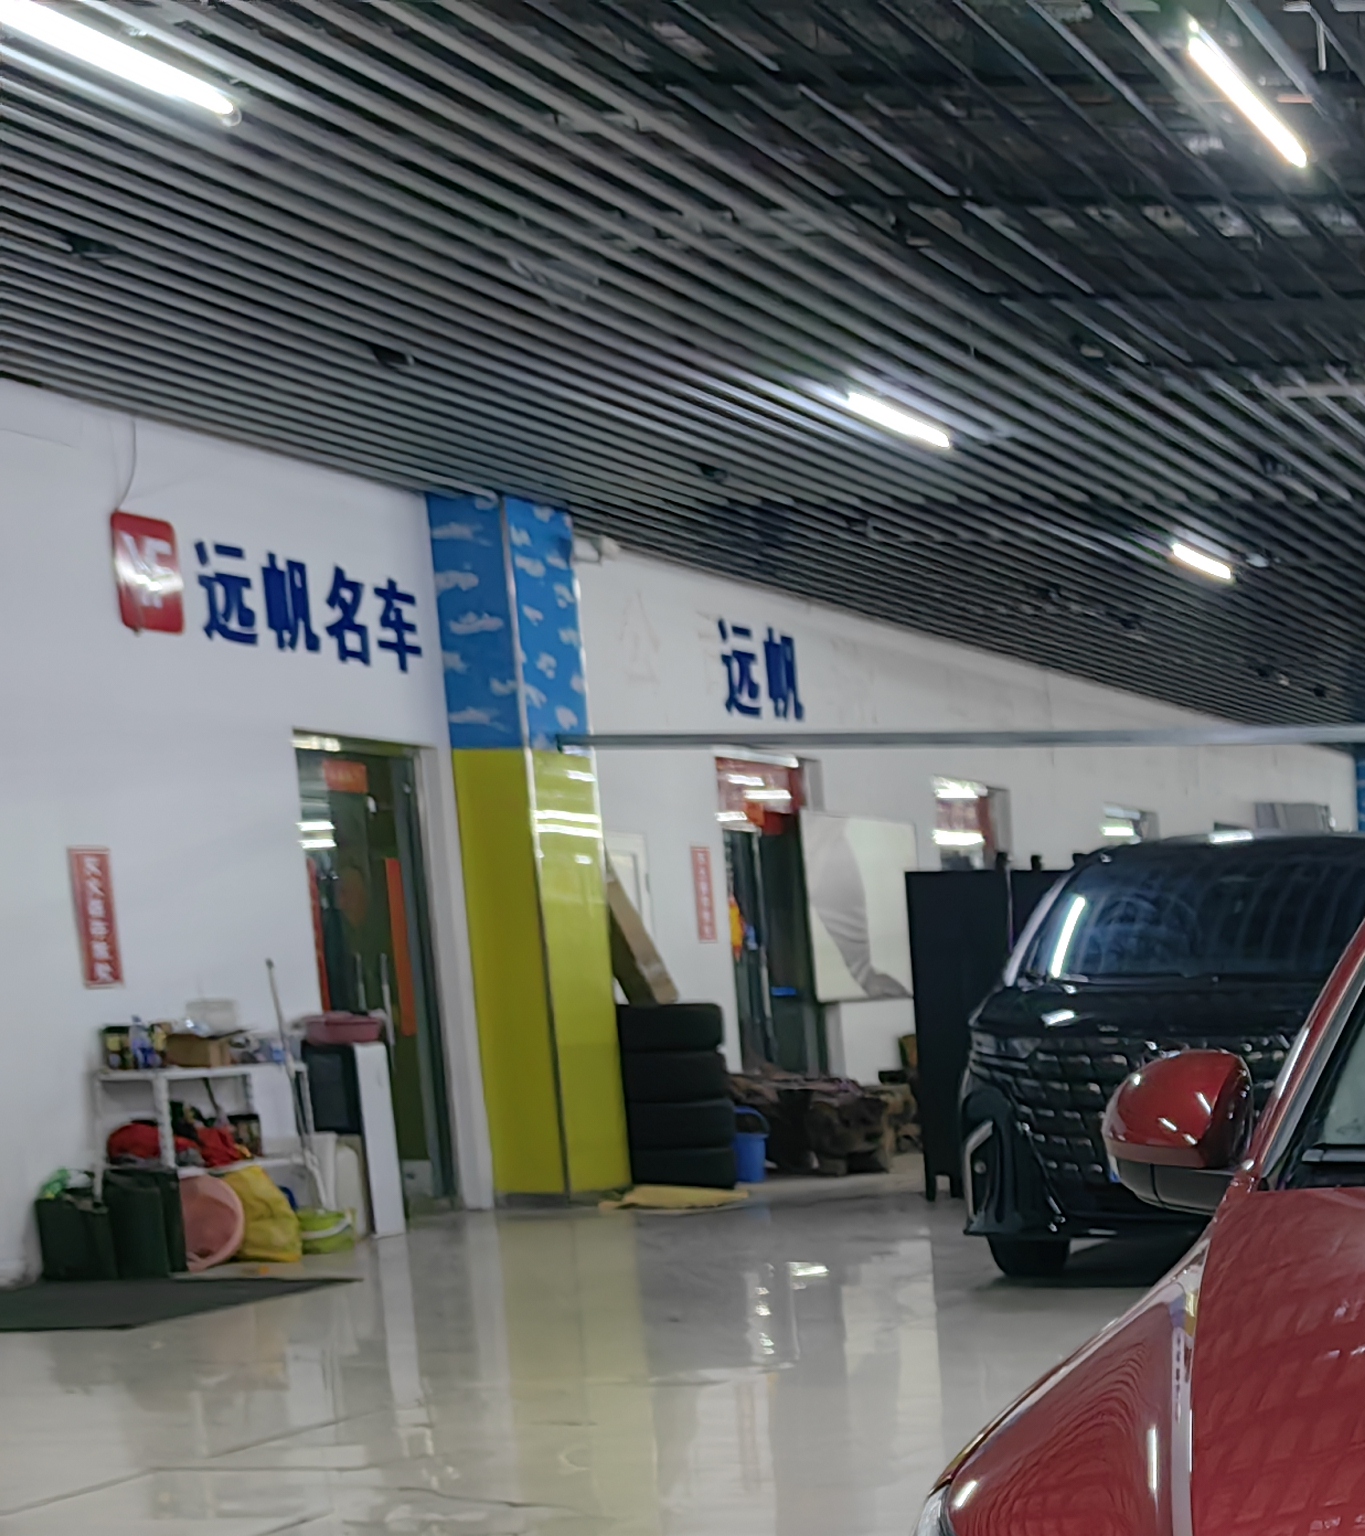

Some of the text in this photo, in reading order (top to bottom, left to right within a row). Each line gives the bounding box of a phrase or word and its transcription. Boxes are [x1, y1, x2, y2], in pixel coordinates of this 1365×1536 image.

[194, 540, 423, 674] 远帆名车
[717, 617, 805, 722] 远帆
